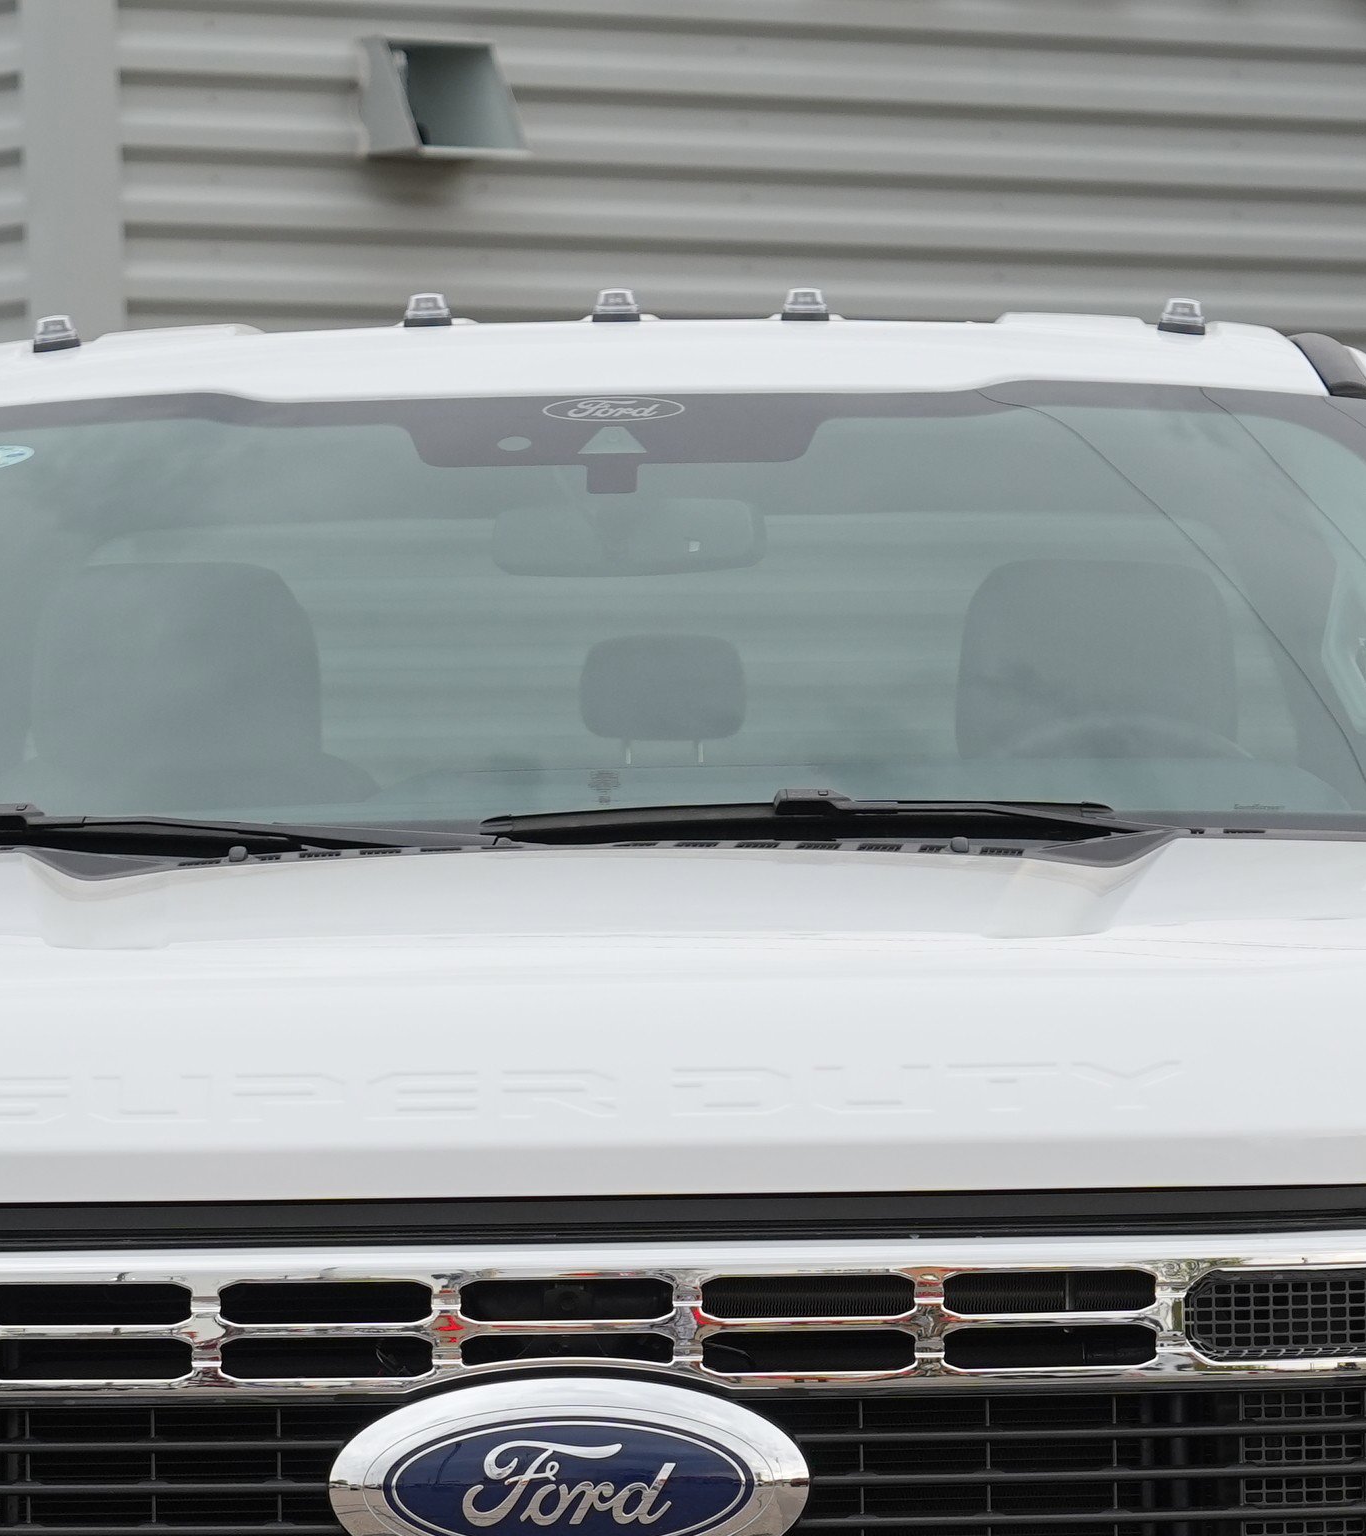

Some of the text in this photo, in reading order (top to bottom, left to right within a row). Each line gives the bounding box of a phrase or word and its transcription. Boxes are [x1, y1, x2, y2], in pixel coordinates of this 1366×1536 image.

[567, 400, 660, 418] Ford
[671, 1060, 1183, 1117] DUTY
[461, 1440, 676, 1527] Ford
